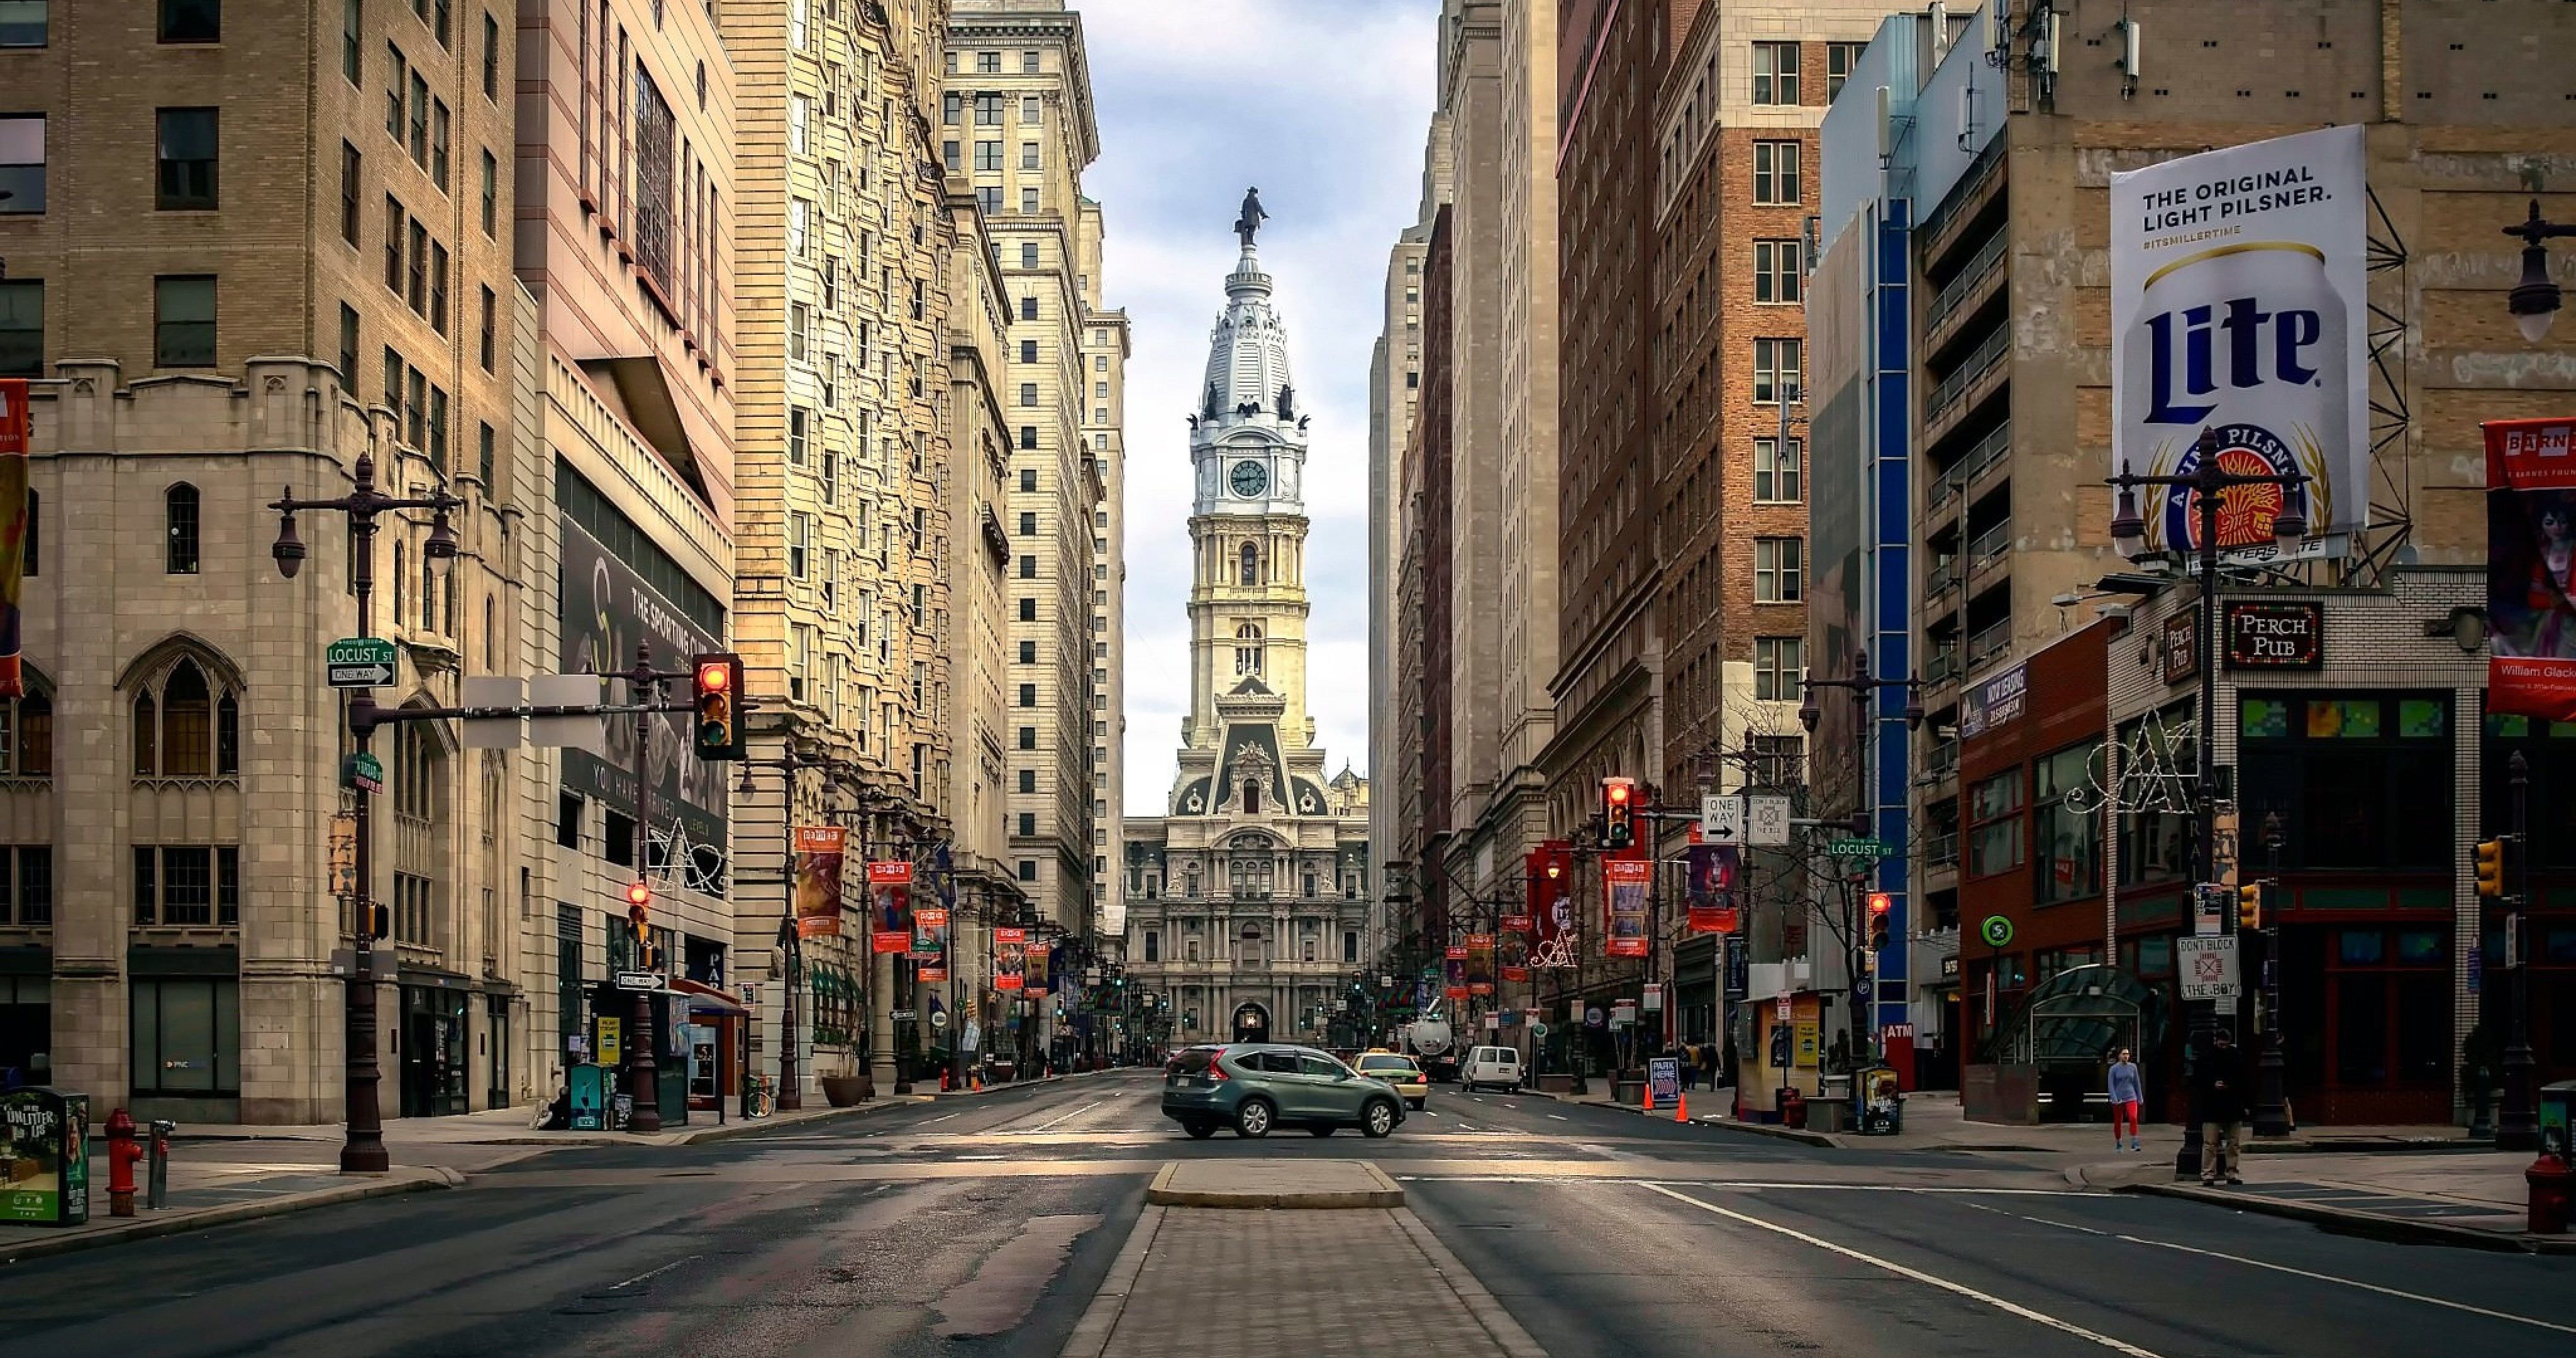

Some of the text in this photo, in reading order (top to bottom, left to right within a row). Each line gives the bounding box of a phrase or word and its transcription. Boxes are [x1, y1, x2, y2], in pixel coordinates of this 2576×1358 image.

[2143, 166, 2313, 210] THE ORIGINAL
[2144, 186, 2331, 232] LIGHT PILSNER.
[2143, 225, 2241, 250] #ITSMILLERTIME
[2143, 297, 2320, 425] Lite
[631, 587, 648, 624] THE
[650, 602, 689, 656] SPORTING
[2241, 615, 2308, 636] PERCH
[2170, 625, 2191, 649] PERCH
[2253, 636, 2295, 656] PUB
[329, 648, 393, 662] LOCUST ST
[2174, 649, 2188, 669] PUB
[335, 669, 374, 679] ONE WAY
[2501, 665, 2540, 676] William
[593, 763, 611, 793] YOU
[616, 775, 638, 806] HAVE
[1710, 800, 1734, 811] ONE
[1709, 812, 1735, 824] WAY
[1831, 844, 1879, 855] LOCUST
[2207, 938, 2235, 950] BLOCK
[2185, 984, 2207, 995] THE
[1887, 1025, 1913, 1037] ATM
[1653, 1061, 1675, 1070] PARK
[1653, 1070, 1675, 1079] HERE
